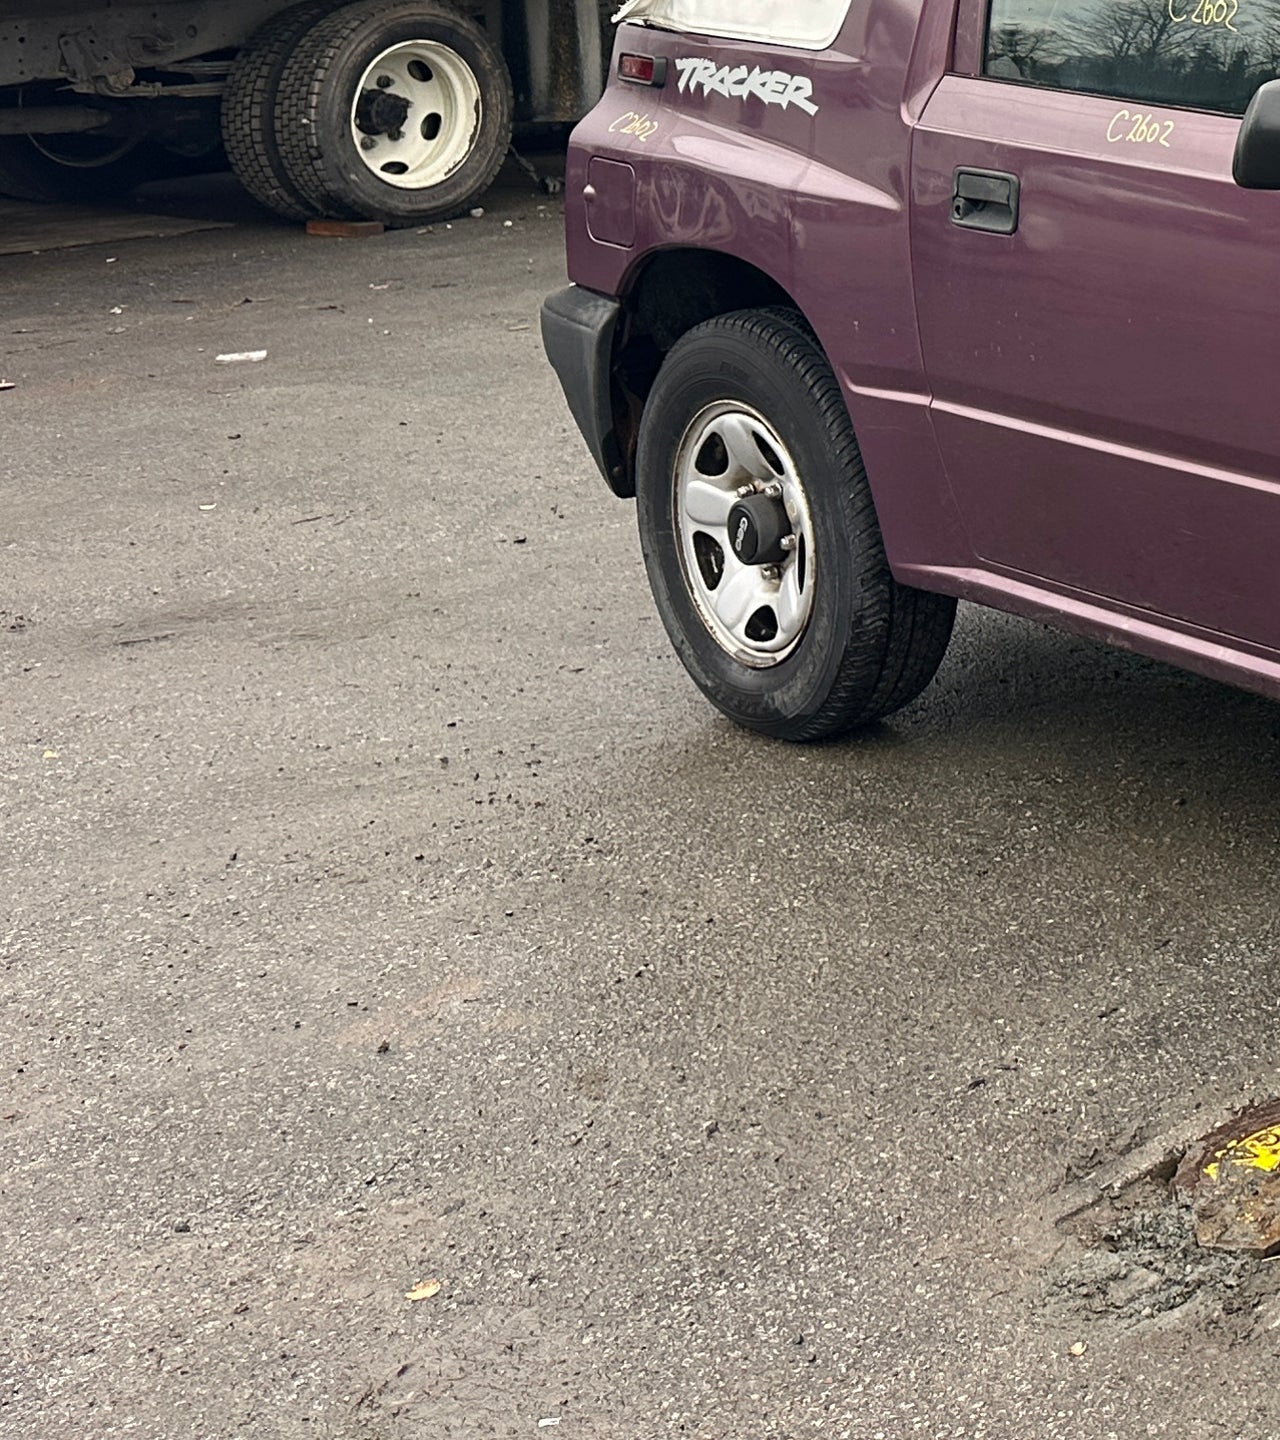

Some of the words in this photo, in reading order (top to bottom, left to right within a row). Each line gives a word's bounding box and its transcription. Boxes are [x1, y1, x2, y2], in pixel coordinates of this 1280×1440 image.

[674, 58, 818, 116] TRACKER
[608, 112, 658, 142] C2602
[1106, 110, 1175, 148] C2602
